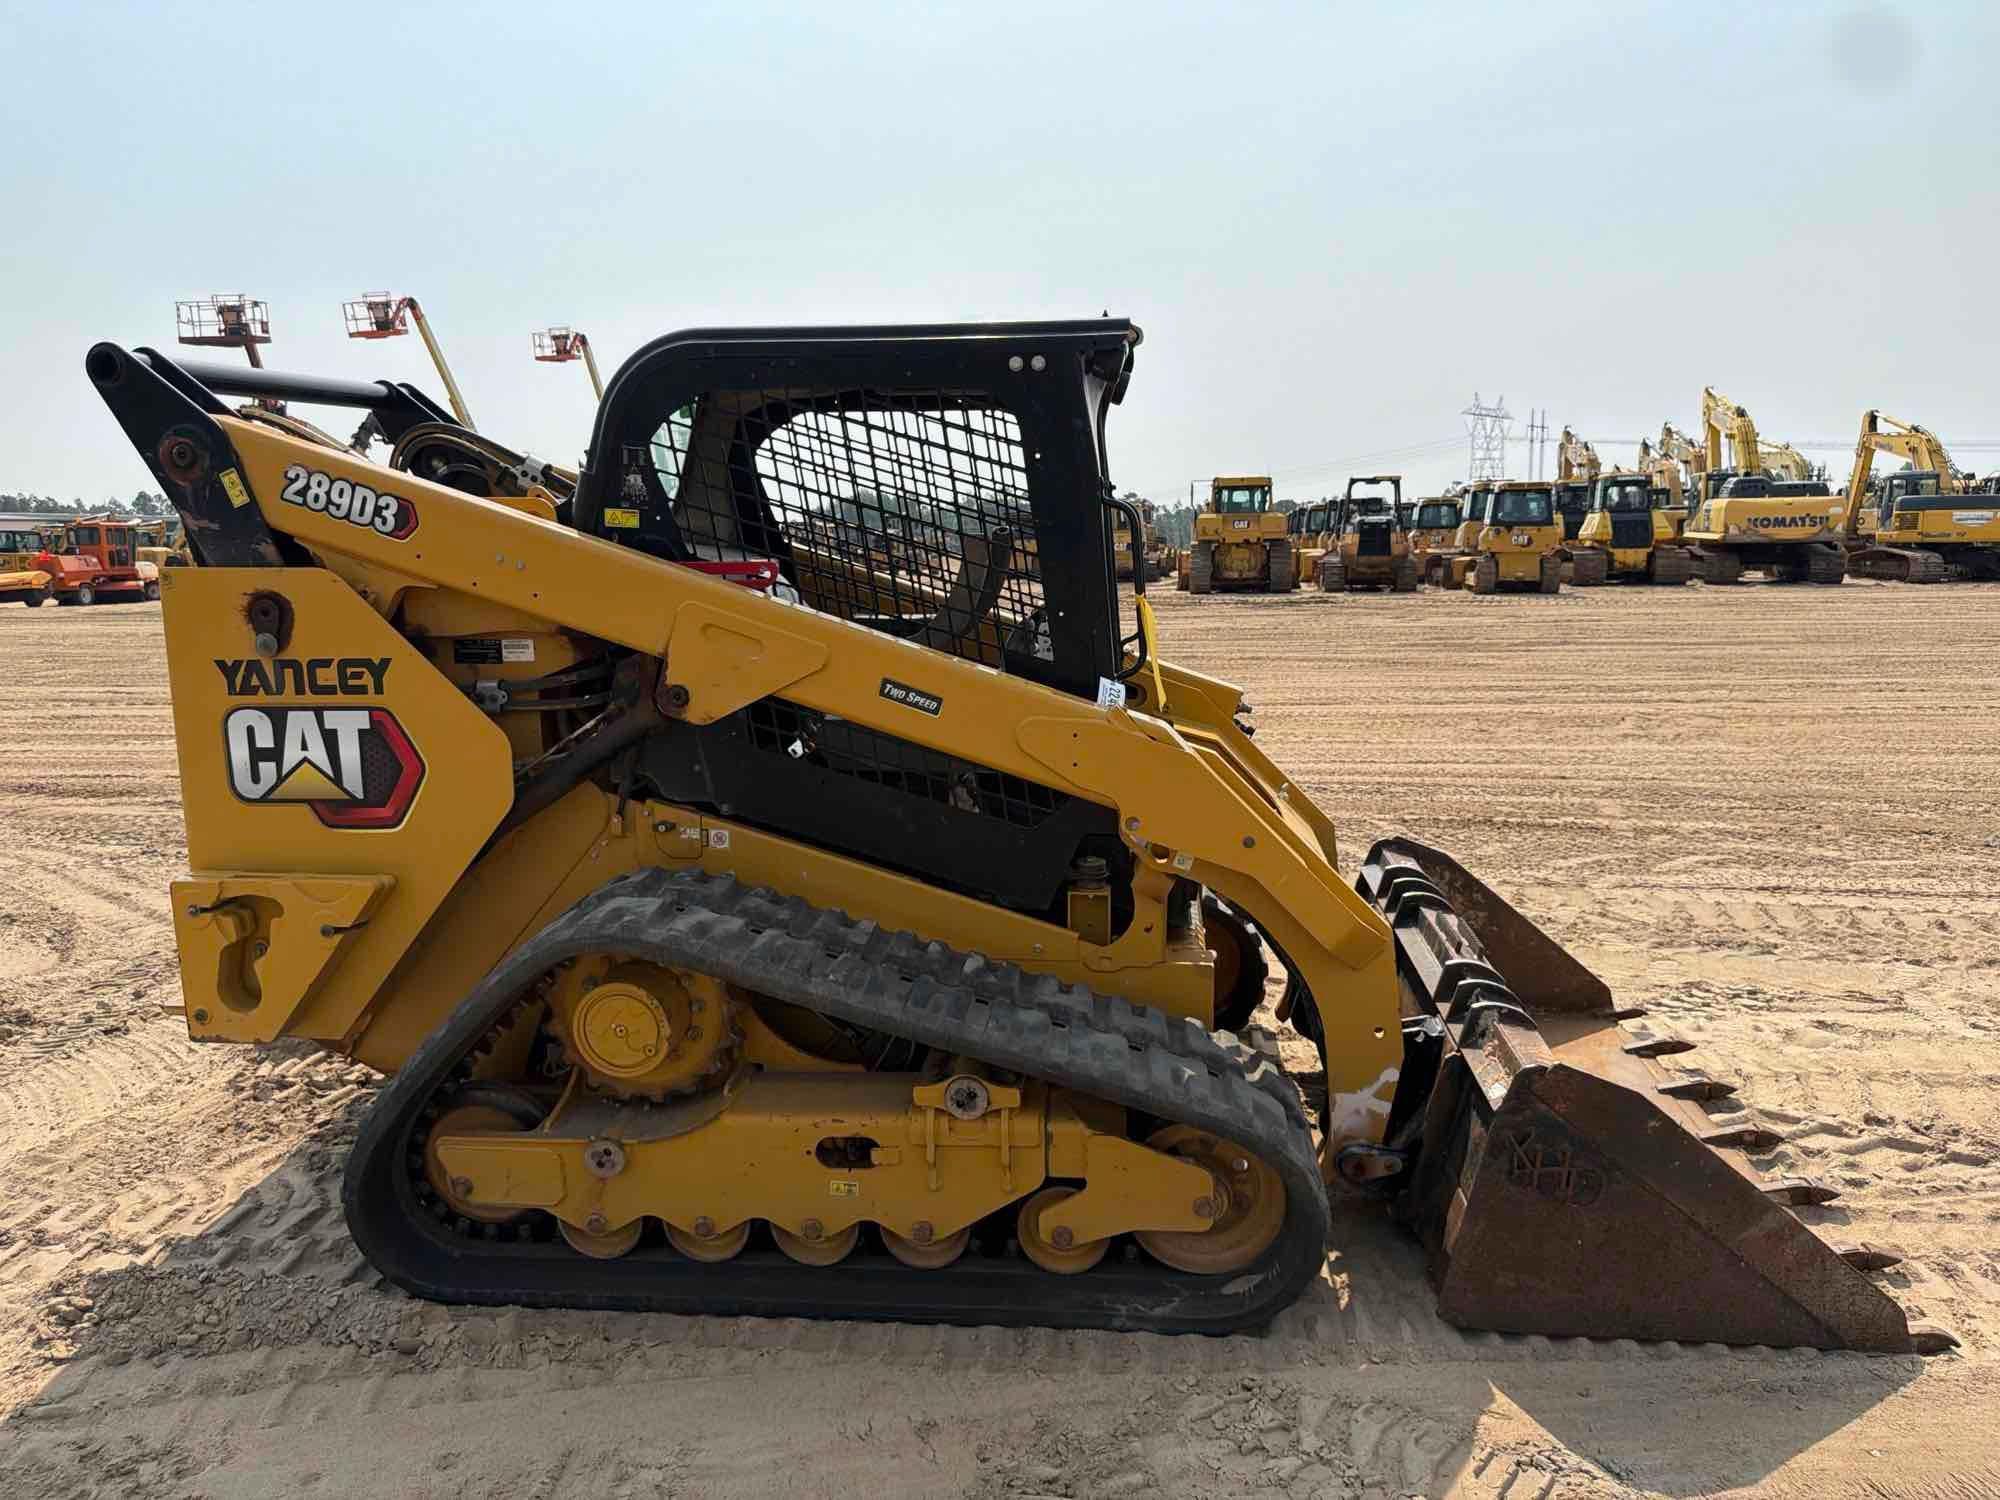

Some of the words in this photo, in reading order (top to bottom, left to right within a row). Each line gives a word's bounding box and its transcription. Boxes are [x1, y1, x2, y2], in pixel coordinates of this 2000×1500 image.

[281, 466, 399, 535] 289D3
[1234, 520, 1248, 529] CAT
[1747, 513, 1830, 528] KOMATSU
[1512, 535, 1528, 545] CAT
[214, 658, 392, 696] YANCEY
[884, 683, 906, 699] TWO
[906, 691, 938, 711] SPEED
[227, 708, 371, 801] CAT
